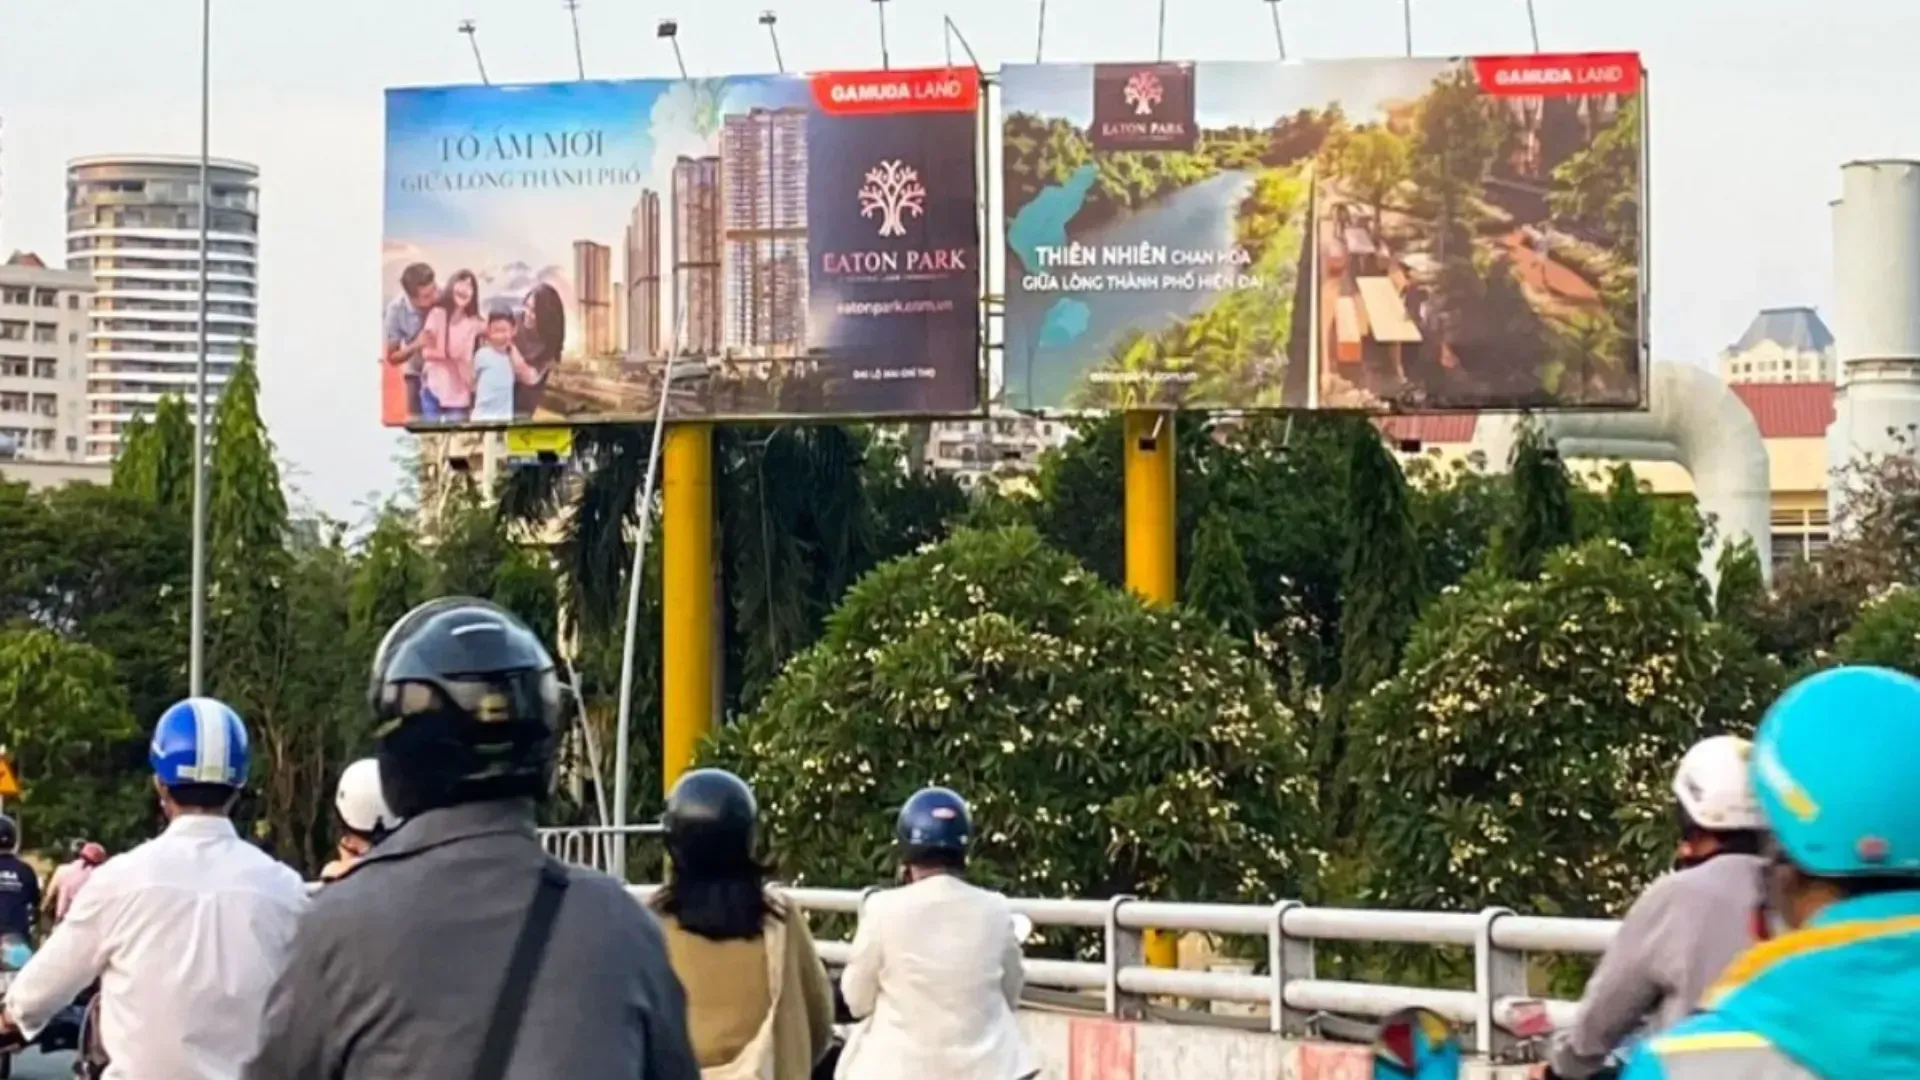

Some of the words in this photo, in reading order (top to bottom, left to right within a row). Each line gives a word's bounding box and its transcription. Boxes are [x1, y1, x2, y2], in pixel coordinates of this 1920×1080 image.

[1494, 67, 1573, 86] GAMUDA
[1577, 65, 1623, 82] LAND
[831, 83, 912, 102] GAMUDA
[914, 80, 962, 98] LAND
[823, 250, 898, 272] EATON
[906, 249, 966, 271] PARK
[1035, 240, 1097, 266] THIÊN
[1102, 240, 1168, 265] NHIÊN
[1171, 250, 1213, 264] CHAN
[1022, 272, 1058, 291] GIỮA
[1062, 273, 1104, 290] LÒNG
[1106, 273, 1158, 289] THÀNH
[1162, 271, 1195, 290] PHỐ
